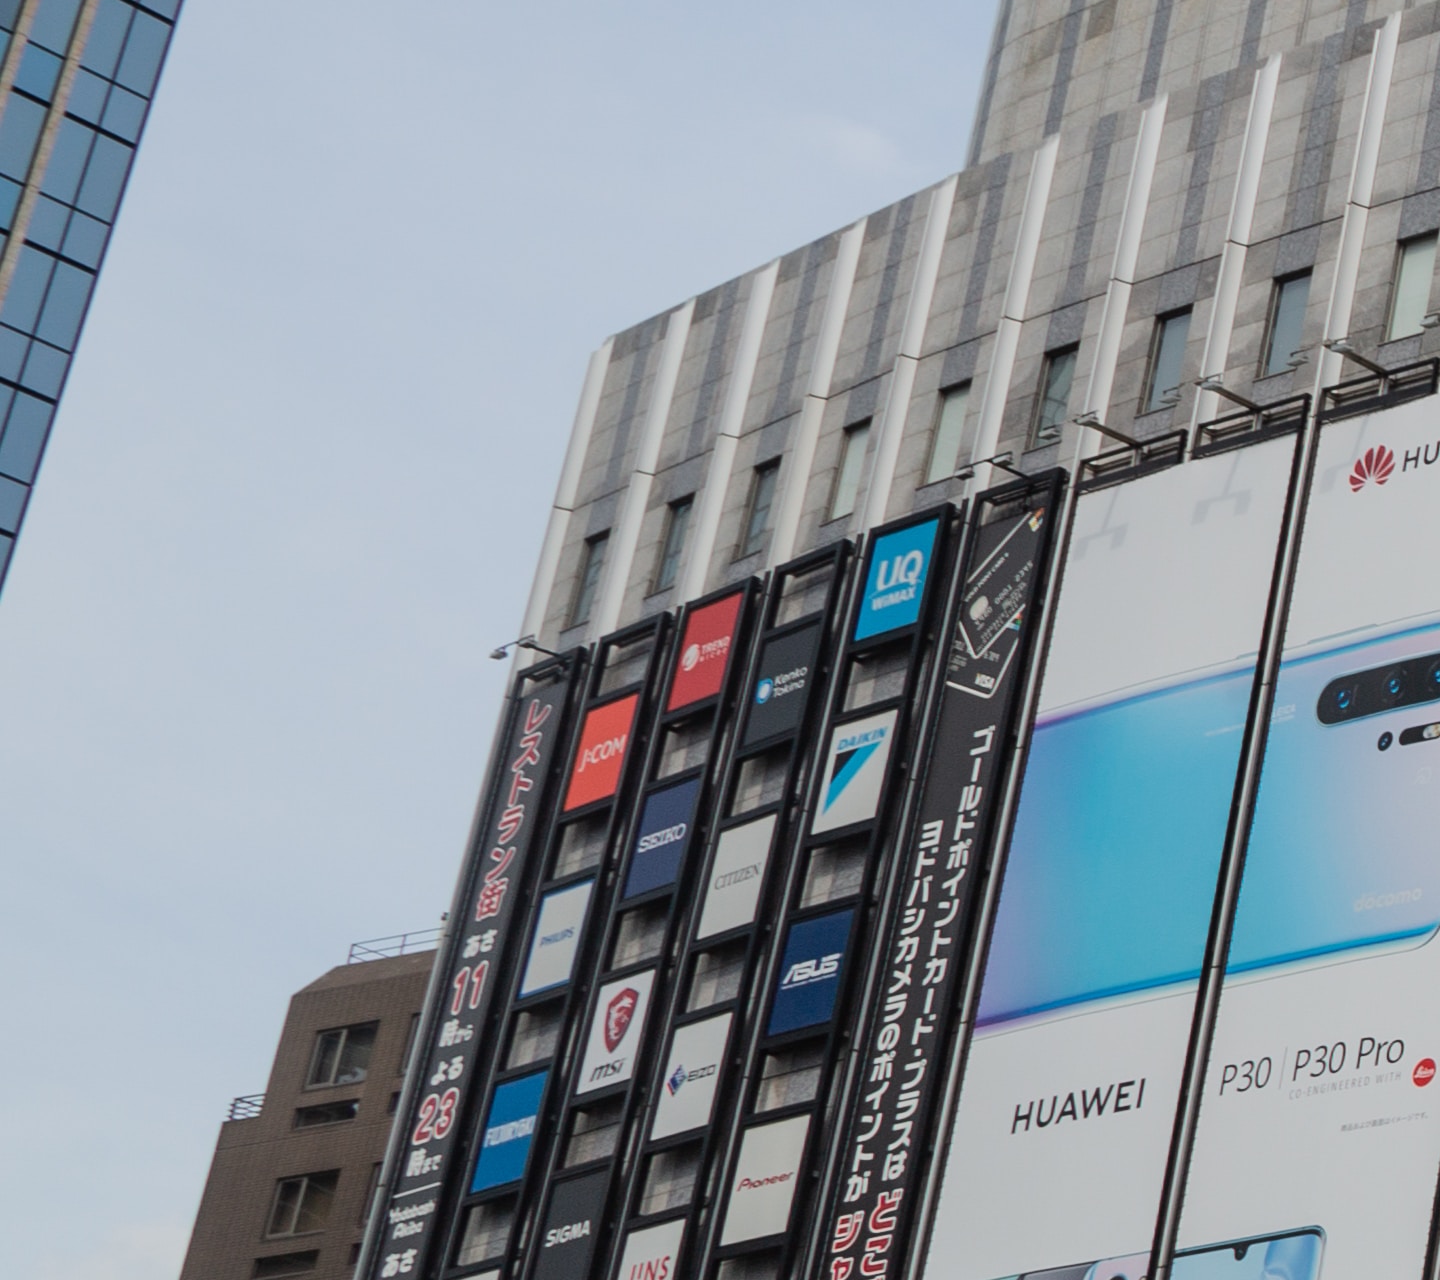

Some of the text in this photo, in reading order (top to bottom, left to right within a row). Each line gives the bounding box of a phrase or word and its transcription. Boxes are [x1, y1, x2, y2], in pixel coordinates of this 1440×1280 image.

[774, 666, 809, 687] Kenko
[577, 733, 627, 773] J:COM
[836, 725, 888, 753] DAIKIN
[476, 699, 552, 921] レストラン街
[637, 823, 688, 854] SEIKO
[714, 862, 762, 892] CITIZEN
[462, 928, 499, 959] あさ
[781, 952, 843, 986] ASUS
[449, 960, 490, 1017] 11
[430, 1054, 465, 1086] よる
[588, 1056, 628, 1083] msi
[1218, 1035, 1406, 1097] P30 P30 Pro
[1288, 1070, 1403, 1101] CO-ENGINEERED WITH
[412, 1086, 461, 1146] 23
[1010, 1077, 1147, 1135] HUAWEI
[736, 1171, 795, 1193] Pioneer
[544, 1220, 591, 1248] SIGMA
[381, 1247, 418, 1278] あさ
